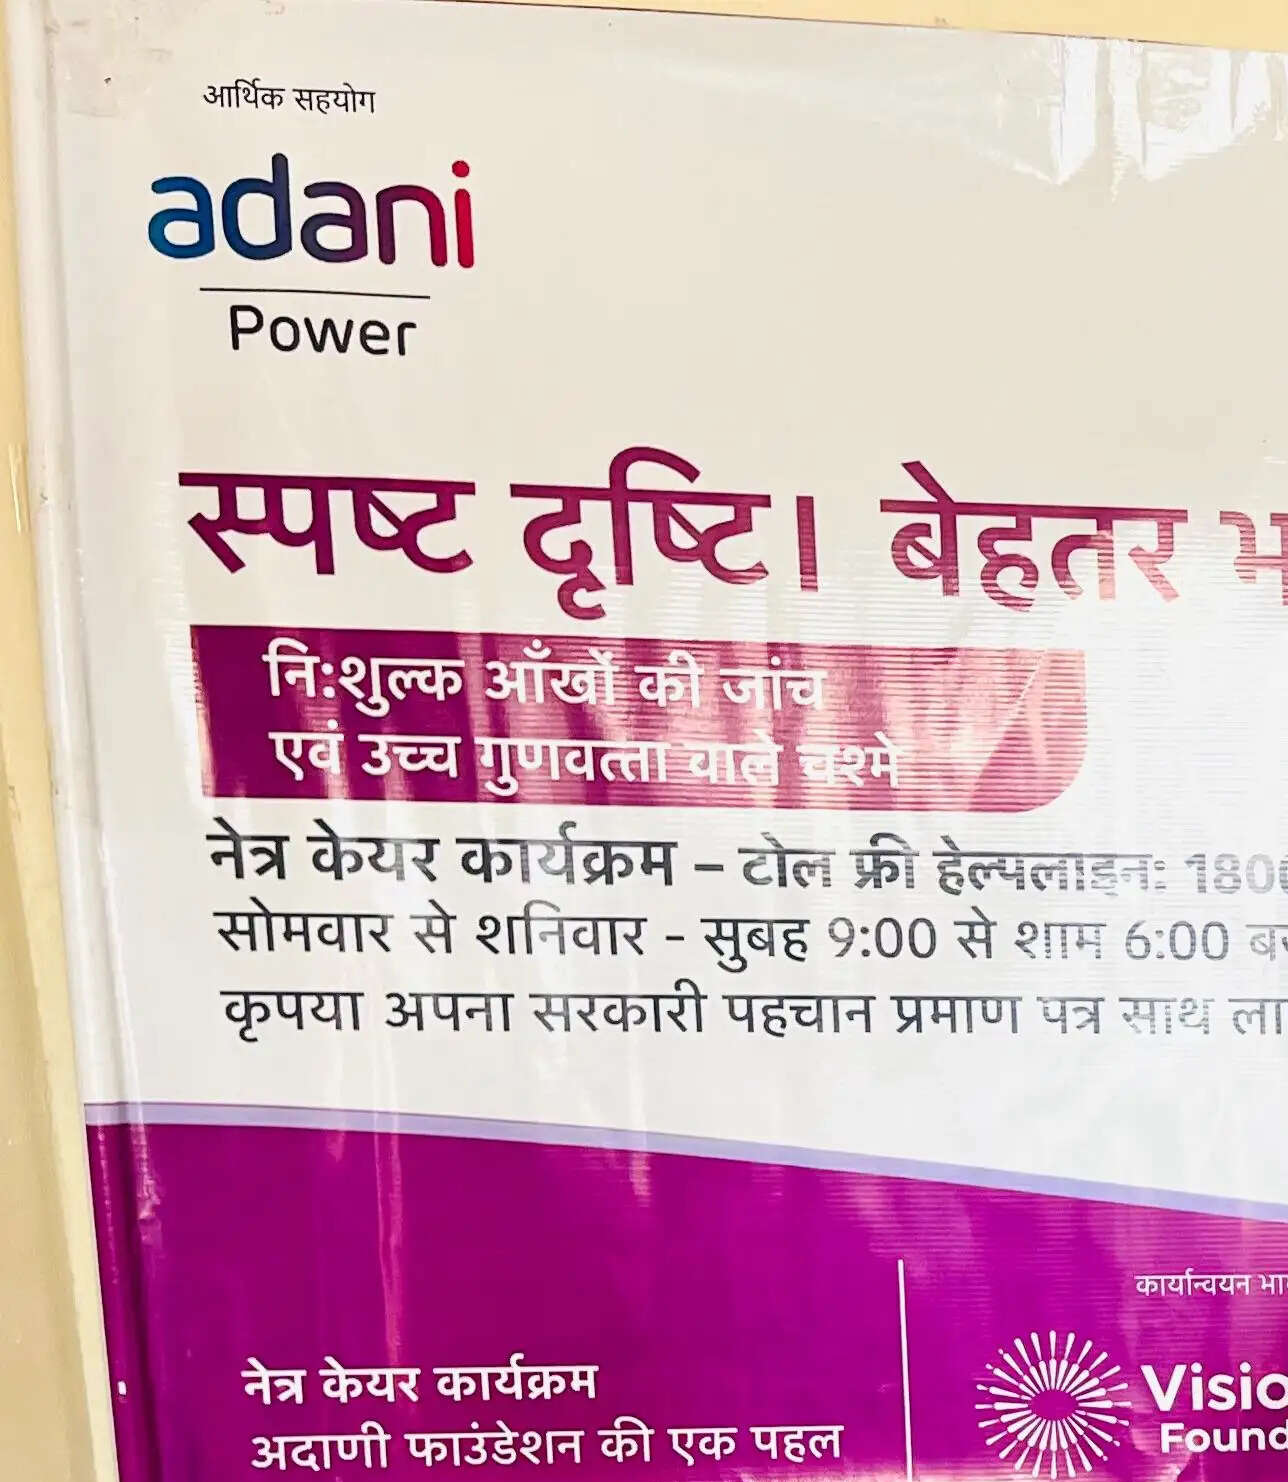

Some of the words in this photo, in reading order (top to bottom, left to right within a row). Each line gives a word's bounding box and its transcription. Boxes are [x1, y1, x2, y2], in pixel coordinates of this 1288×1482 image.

[202, 81, 284, 111] आर्थिक
[293, 83, 376, 114] सहयोग
[148, 153, 475, 269] adani
[229, 304, 418, 357] Power
[179, 473, 475, 575] स्पष्ट
[510, 446, 818, 620] दृष्टि।
[880, 461, 1188, 612] बेहतर
[484, 640, 617, 706] आँखों
[636, 648, 701, 708] की
[719, 655, 827, 711] जांच
[268, 719, 343, 780] एवं
[359, 733, 461, 779] उच्च
[473, 738, 671, 796] गुणवत्ता
[673, 731, 779, 787] वाले
[782, 731, 899, 789] चश्मे
[206, 816, 290, 880] नेत्र
[306, 818, 440, 882] केयर
[455, 821, 678, 887] कार्यक्रम
[737, 831, 835, 889] टोल
[849, 832, 920, 892] फ्री
[213, 896, 393, 953] सोमवार
[409, 899, 457, 954] से
[475, 899, 648, 956] शनिवार
[700, 917, 810, 973] सुबह
[828, 915, 937, 959] 9:00
[953, 905, 998, 959] से
[1013, 922, 1107, 962] शाम
[1125, 918, 1231, 962] 6:00
[220, 989, 364, 1042] कृपया
[385, 991, 515, 1033] अपना
[529, 978, 706, 1034] सरकारी
[721, 995, 876, 1038] पहचान
[890, 995, 1023, 1037] प्रमाण
[1036, 997, 1106, 1036] पत्र
[1120, 997, 1214, 1037] साथ
[1135, 1266, 1252, 1297] कार्यान्वयन
[241, 1357, 307, 1405] नेत्र
[319, 1356, 421, 1404] केयर
[433, 1353, 599, 1401] कार्यक्रम
[251, 1421, 393, 1471] अदाणी
[404, 1420, 586, 1468] फाउंडेशन
[597, 1415, 655, 1465] की
[669, 1427, 738, 1464] एक
[750, 1423, 845, 1463] पहल
